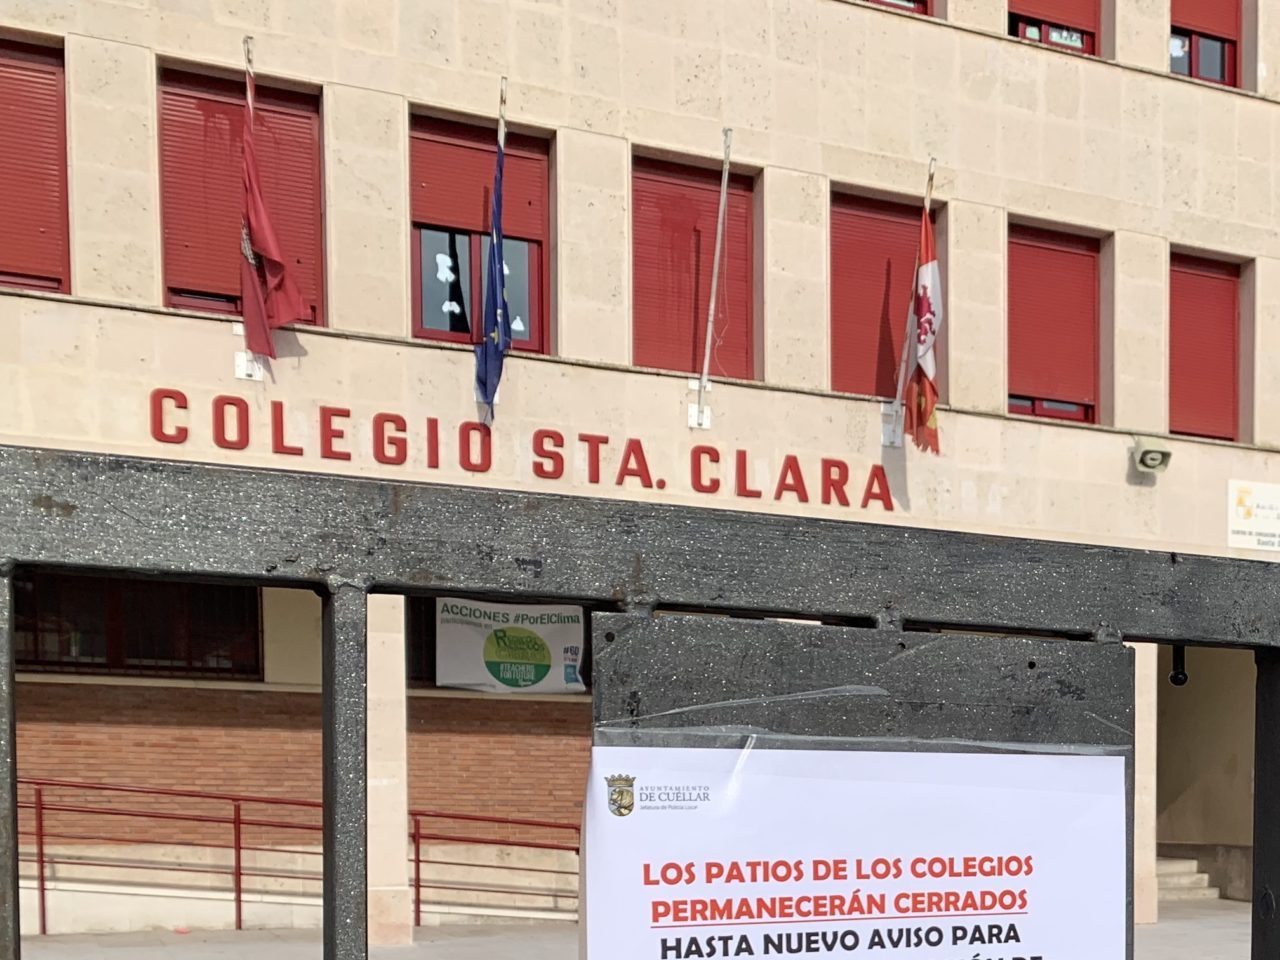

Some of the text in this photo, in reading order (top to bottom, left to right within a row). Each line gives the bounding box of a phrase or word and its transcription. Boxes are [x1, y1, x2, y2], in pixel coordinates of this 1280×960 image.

[150, 388, 894, 511] COLEGIO STA. CLARA
[440, 603, 580, 625] ACCIONES #PorElClima
[640, 790, 711, 802] DE CUÉLLAR
[643, 856, 1034, 886] LOS PATIOS DE LOS COLEGIOS
[651, 890, 1028, 923] PERMANECERÁN CERRADOS
[661, 924, 1020, 959] HASTA NUEVO AVISO PARA
